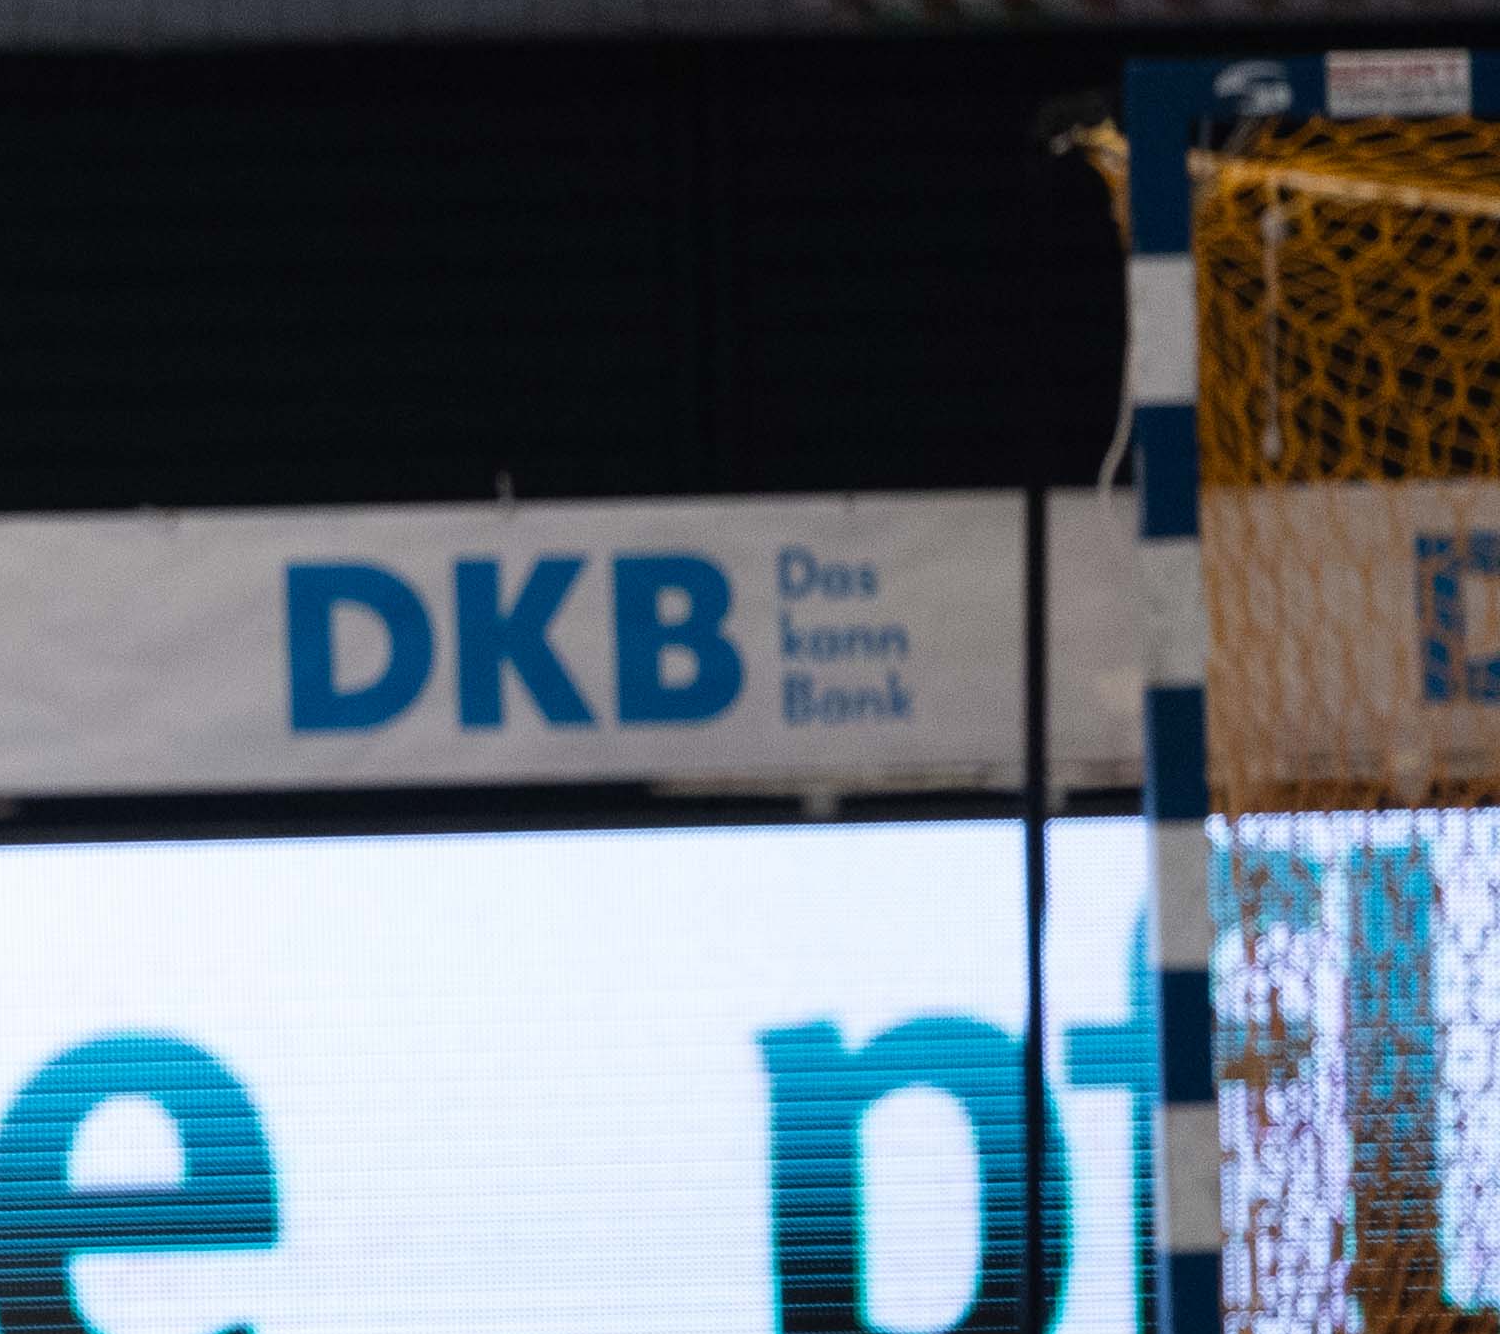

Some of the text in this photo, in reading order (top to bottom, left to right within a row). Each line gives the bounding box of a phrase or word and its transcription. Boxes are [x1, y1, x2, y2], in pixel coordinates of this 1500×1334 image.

[776, 546, 879, 602] Das
[284, 553, 746, 735] DKB
[780, 613, 909, 663] kann
[781, 673, 911, 727] Bank
